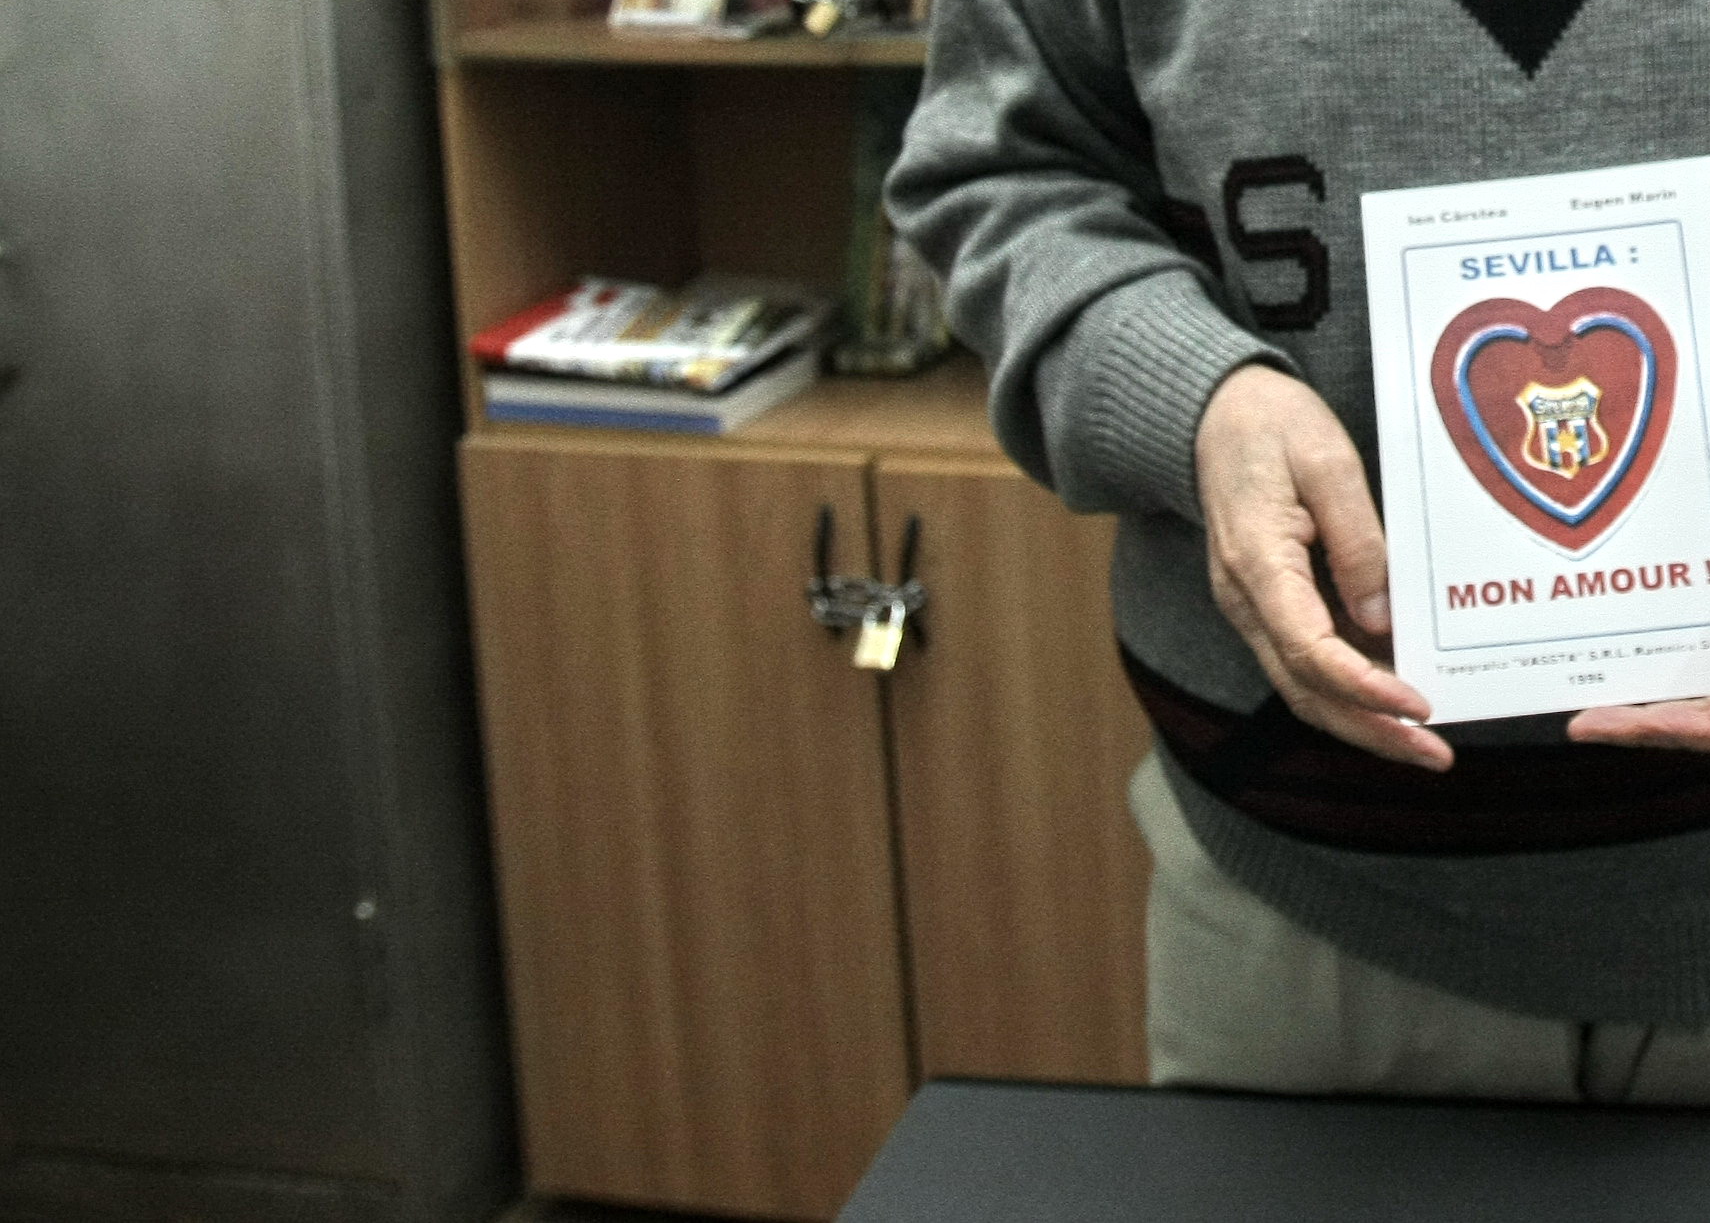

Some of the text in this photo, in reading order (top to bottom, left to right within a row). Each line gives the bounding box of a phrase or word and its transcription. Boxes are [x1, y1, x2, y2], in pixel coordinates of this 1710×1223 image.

[1223, 155, 1330, 330] S
[1460, 243, 1617, 280] SEVILLA
[1446, 577, 1536, 610] MON
[1550, 562, 1692, 601] AMOUR
